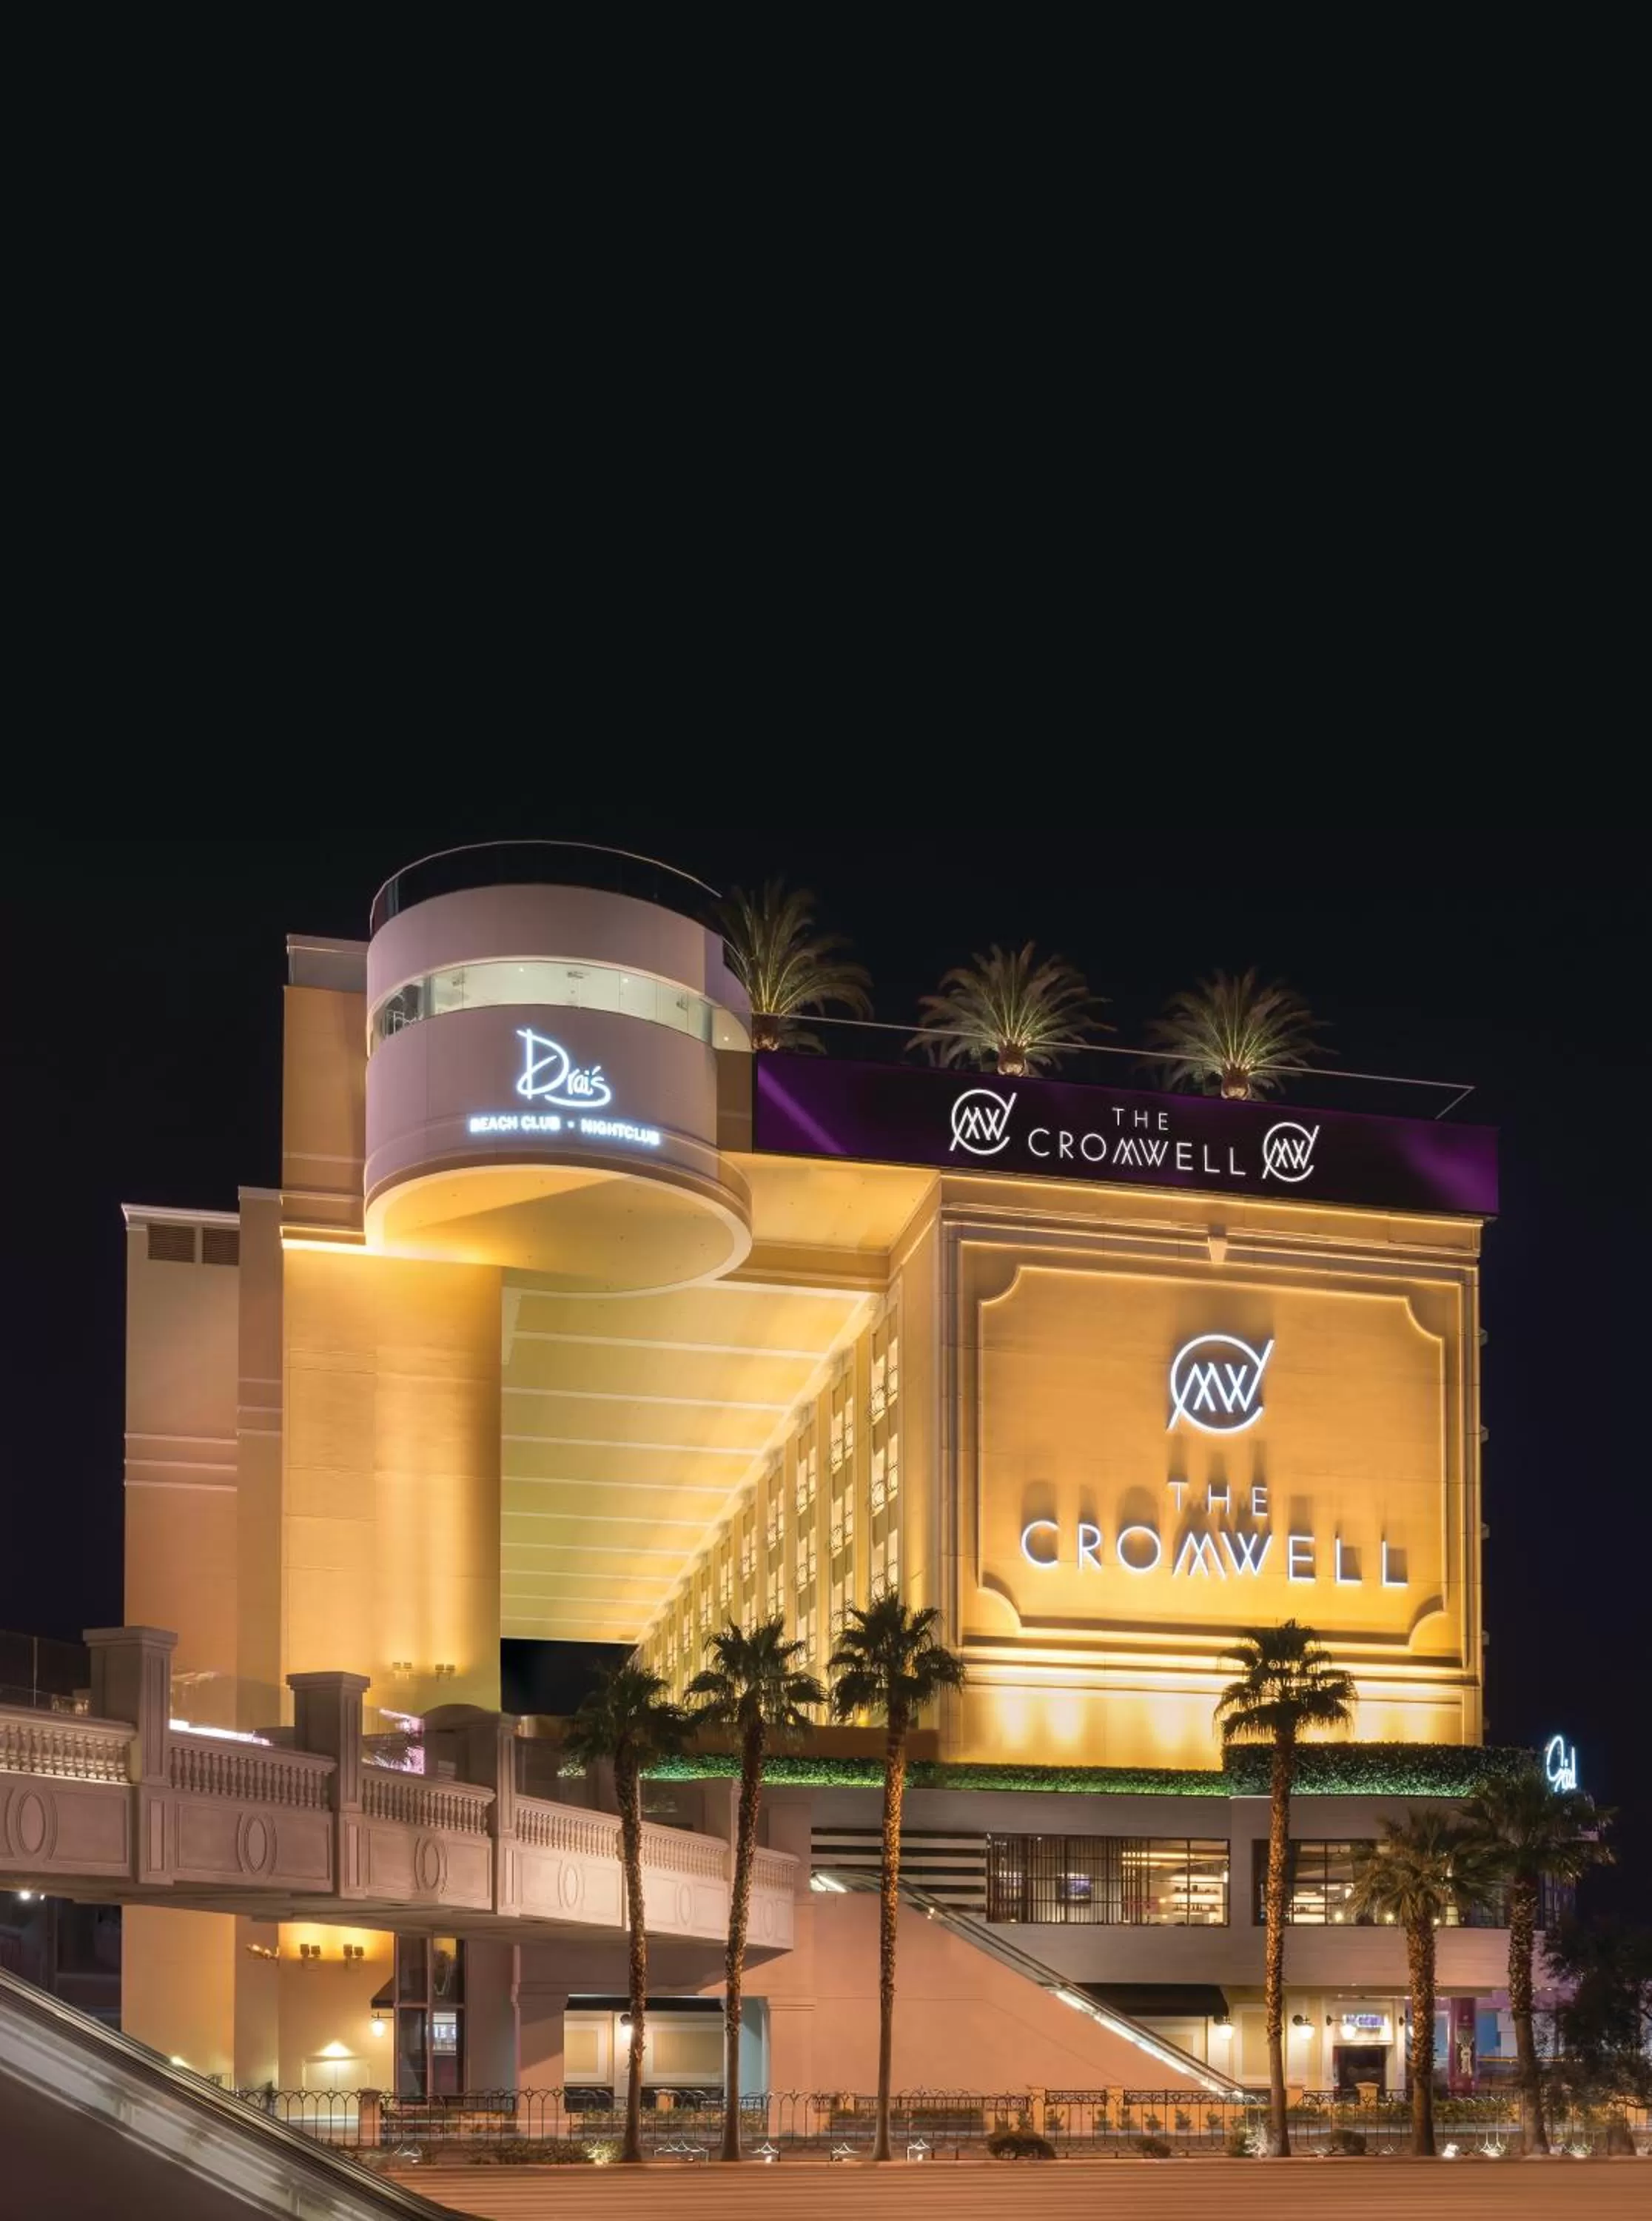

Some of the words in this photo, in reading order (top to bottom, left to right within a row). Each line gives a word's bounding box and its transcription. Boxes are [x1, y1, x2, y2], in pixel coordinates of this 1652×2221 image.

[469, 1116, 518, 1133] BEACH
[520, 1116, 560, 1130] CLUB
[581, 1118, 660, 1145] NIGHTCLUB
[1112, 1107, 1169, 1130] THE
[1028, 1128, 1246, 1176] CROMWELL
[1167, 1481, 1269, 1517] THE
[1021, 1520, 1408, 1587] CROMWELL
